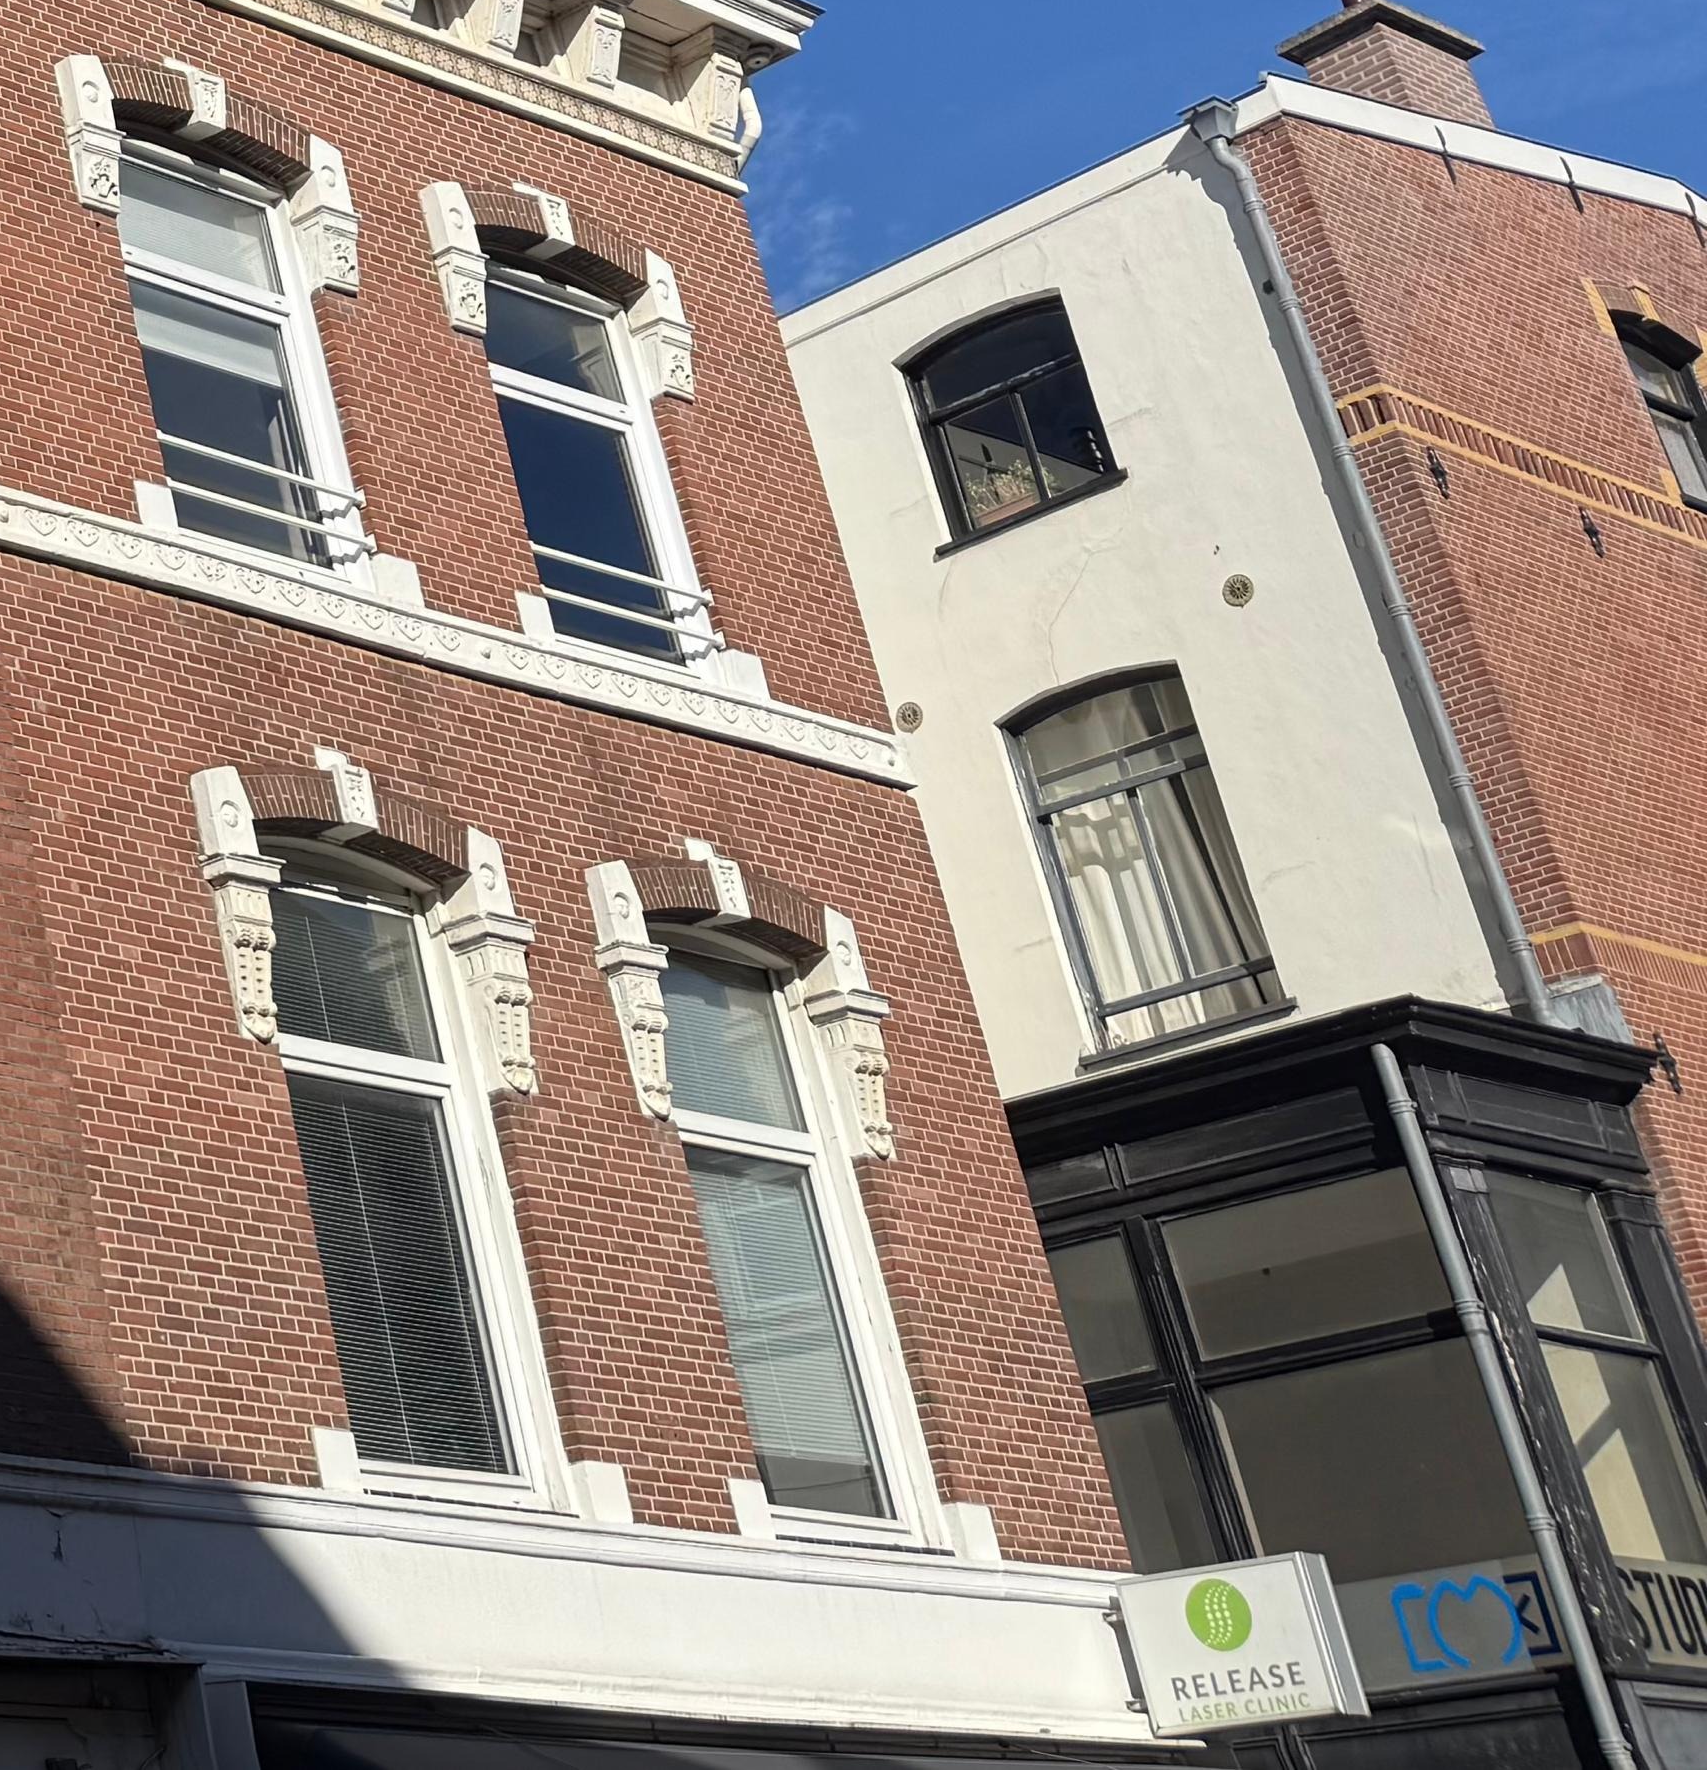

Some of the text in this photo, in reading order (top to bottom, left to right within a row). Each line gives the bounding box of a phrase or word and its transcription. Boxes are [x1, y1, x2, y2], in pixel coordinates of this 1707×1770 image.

[1615, 1566, 1707, 1656] STUD
[1171, 1661, 1306, 1701] RELEASE
[1179, 1692, 1311, 1723] LASER CLINIC
